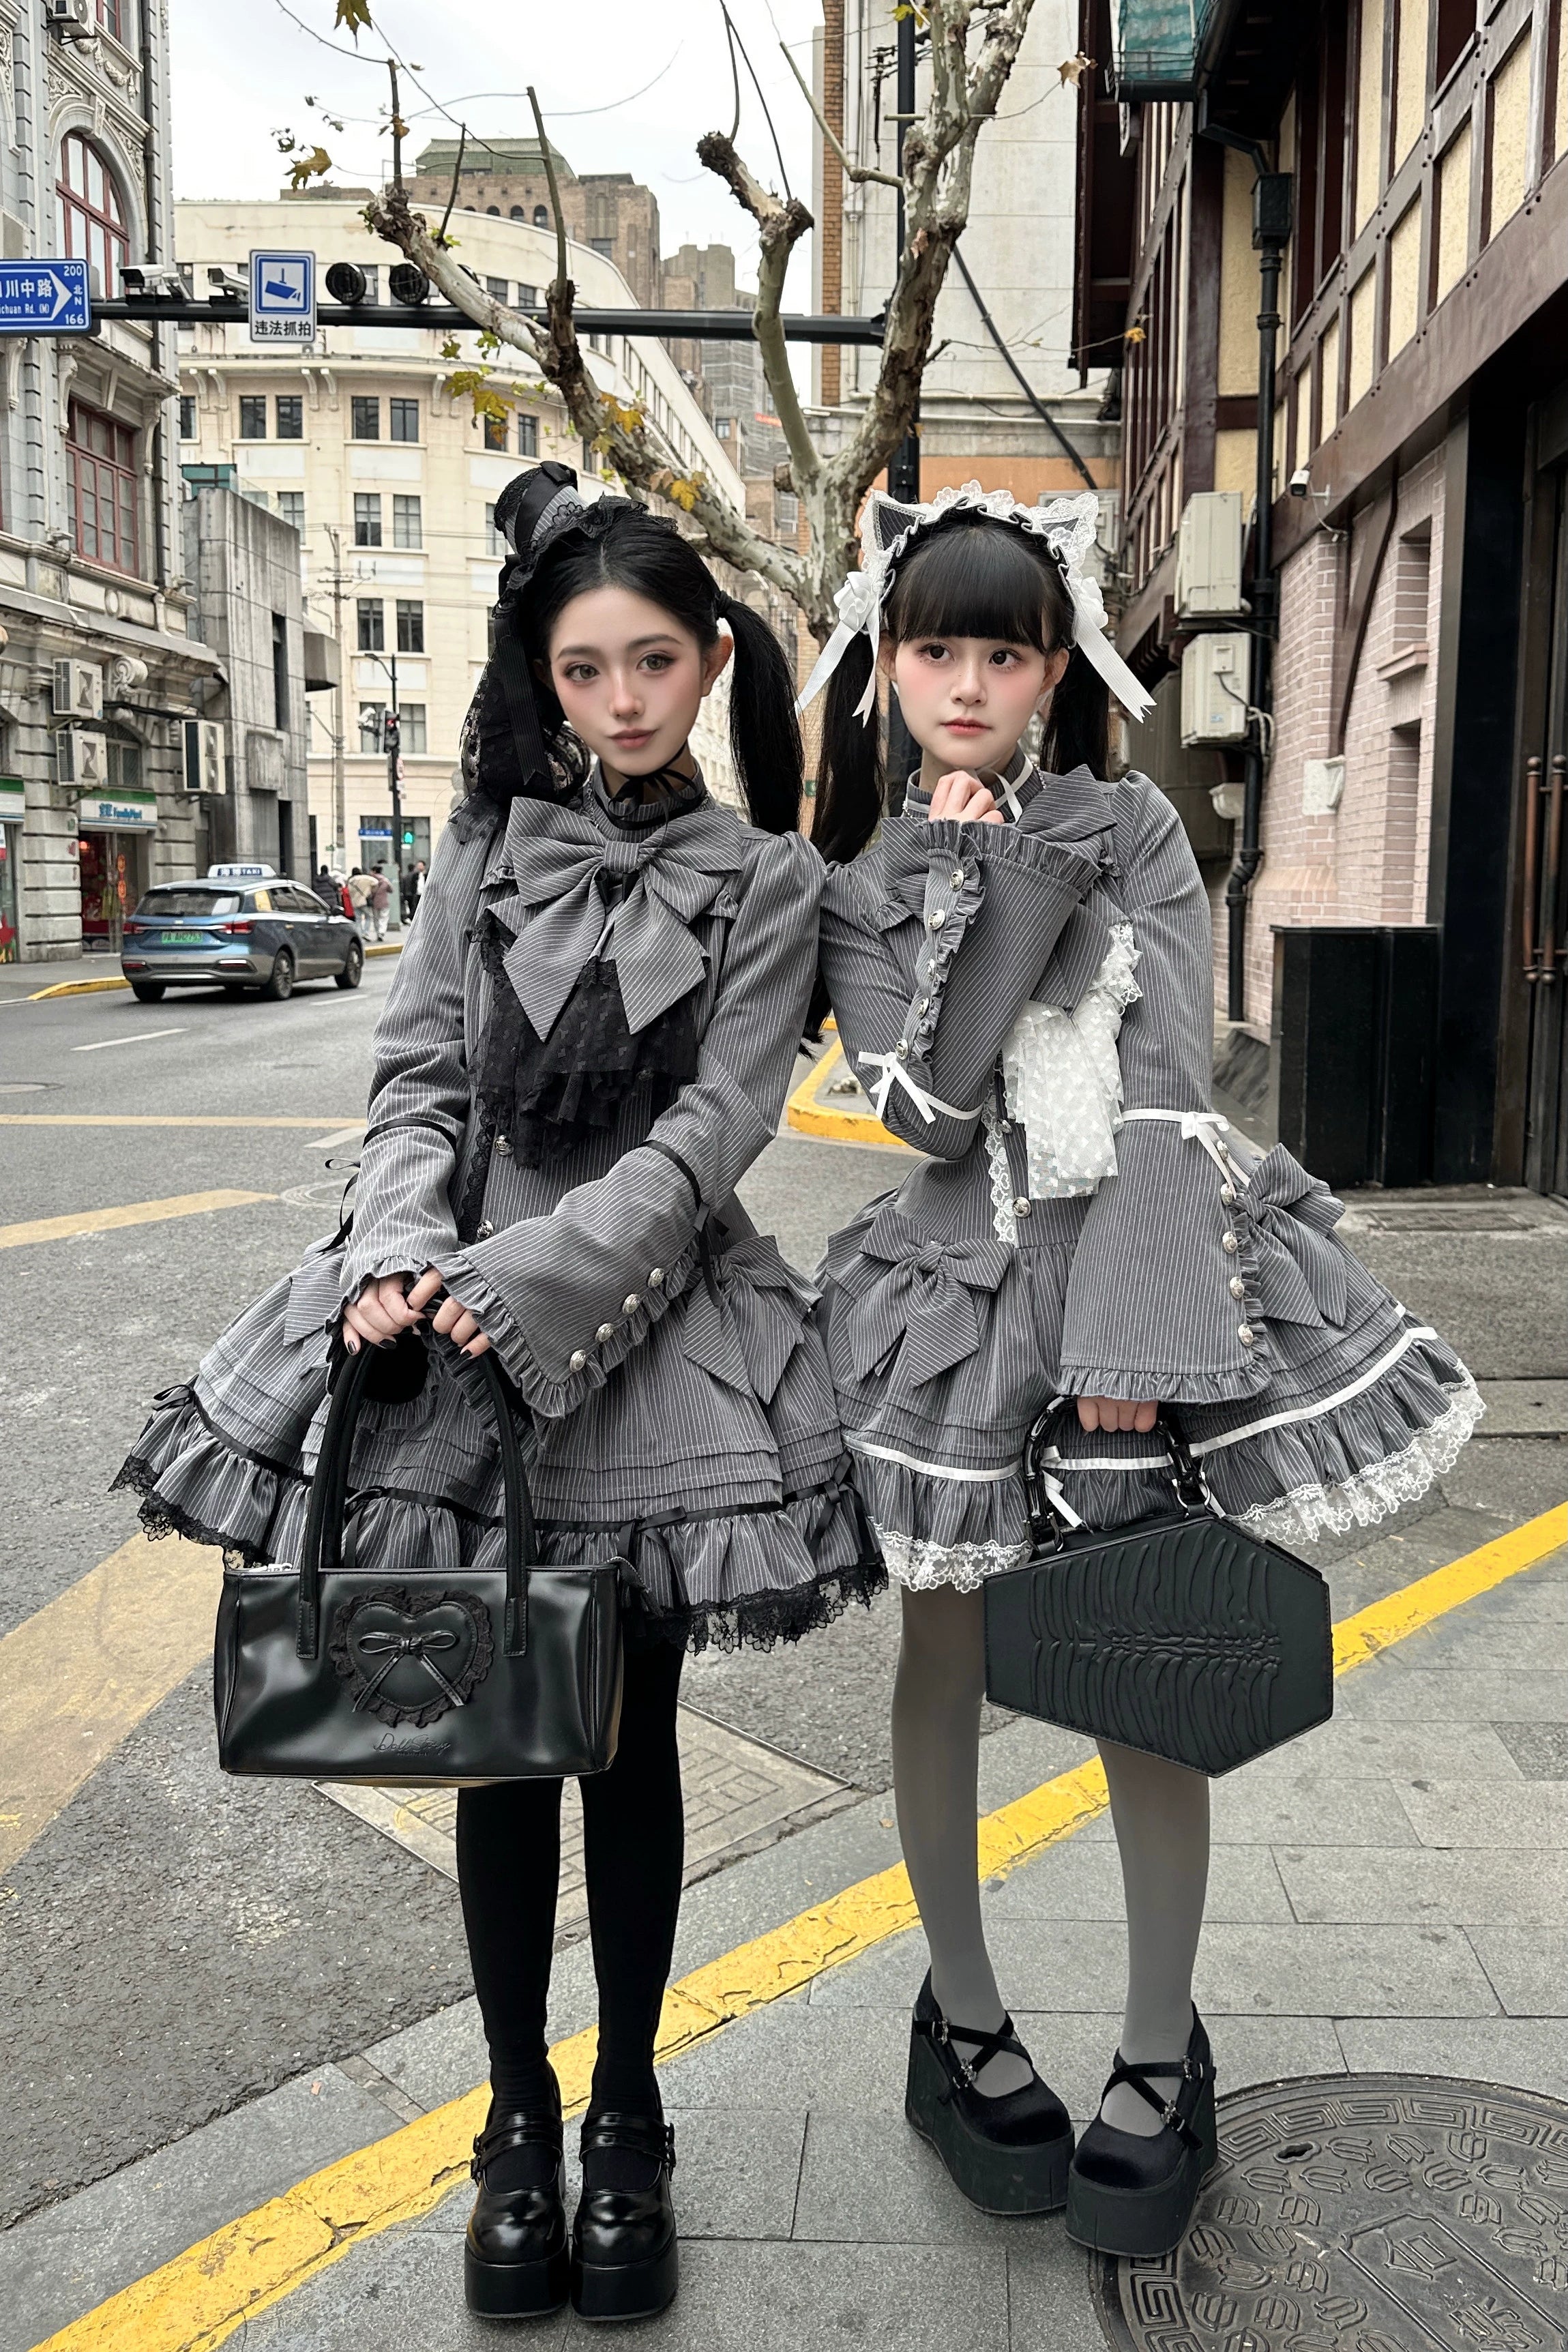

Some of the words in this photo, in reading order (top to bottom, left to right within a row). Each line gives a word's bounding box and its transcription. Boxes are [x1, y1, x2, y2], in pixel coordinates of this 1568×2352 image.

[63, 265, 83, 276] 200
[0, 278, 53, 298] 川中路
[73, 284, 83, 295] 北
[74, 297, 82, 306] N
[65, 314, 84, 325] 166
[254, 320, 311, 336] 违法抓拍
